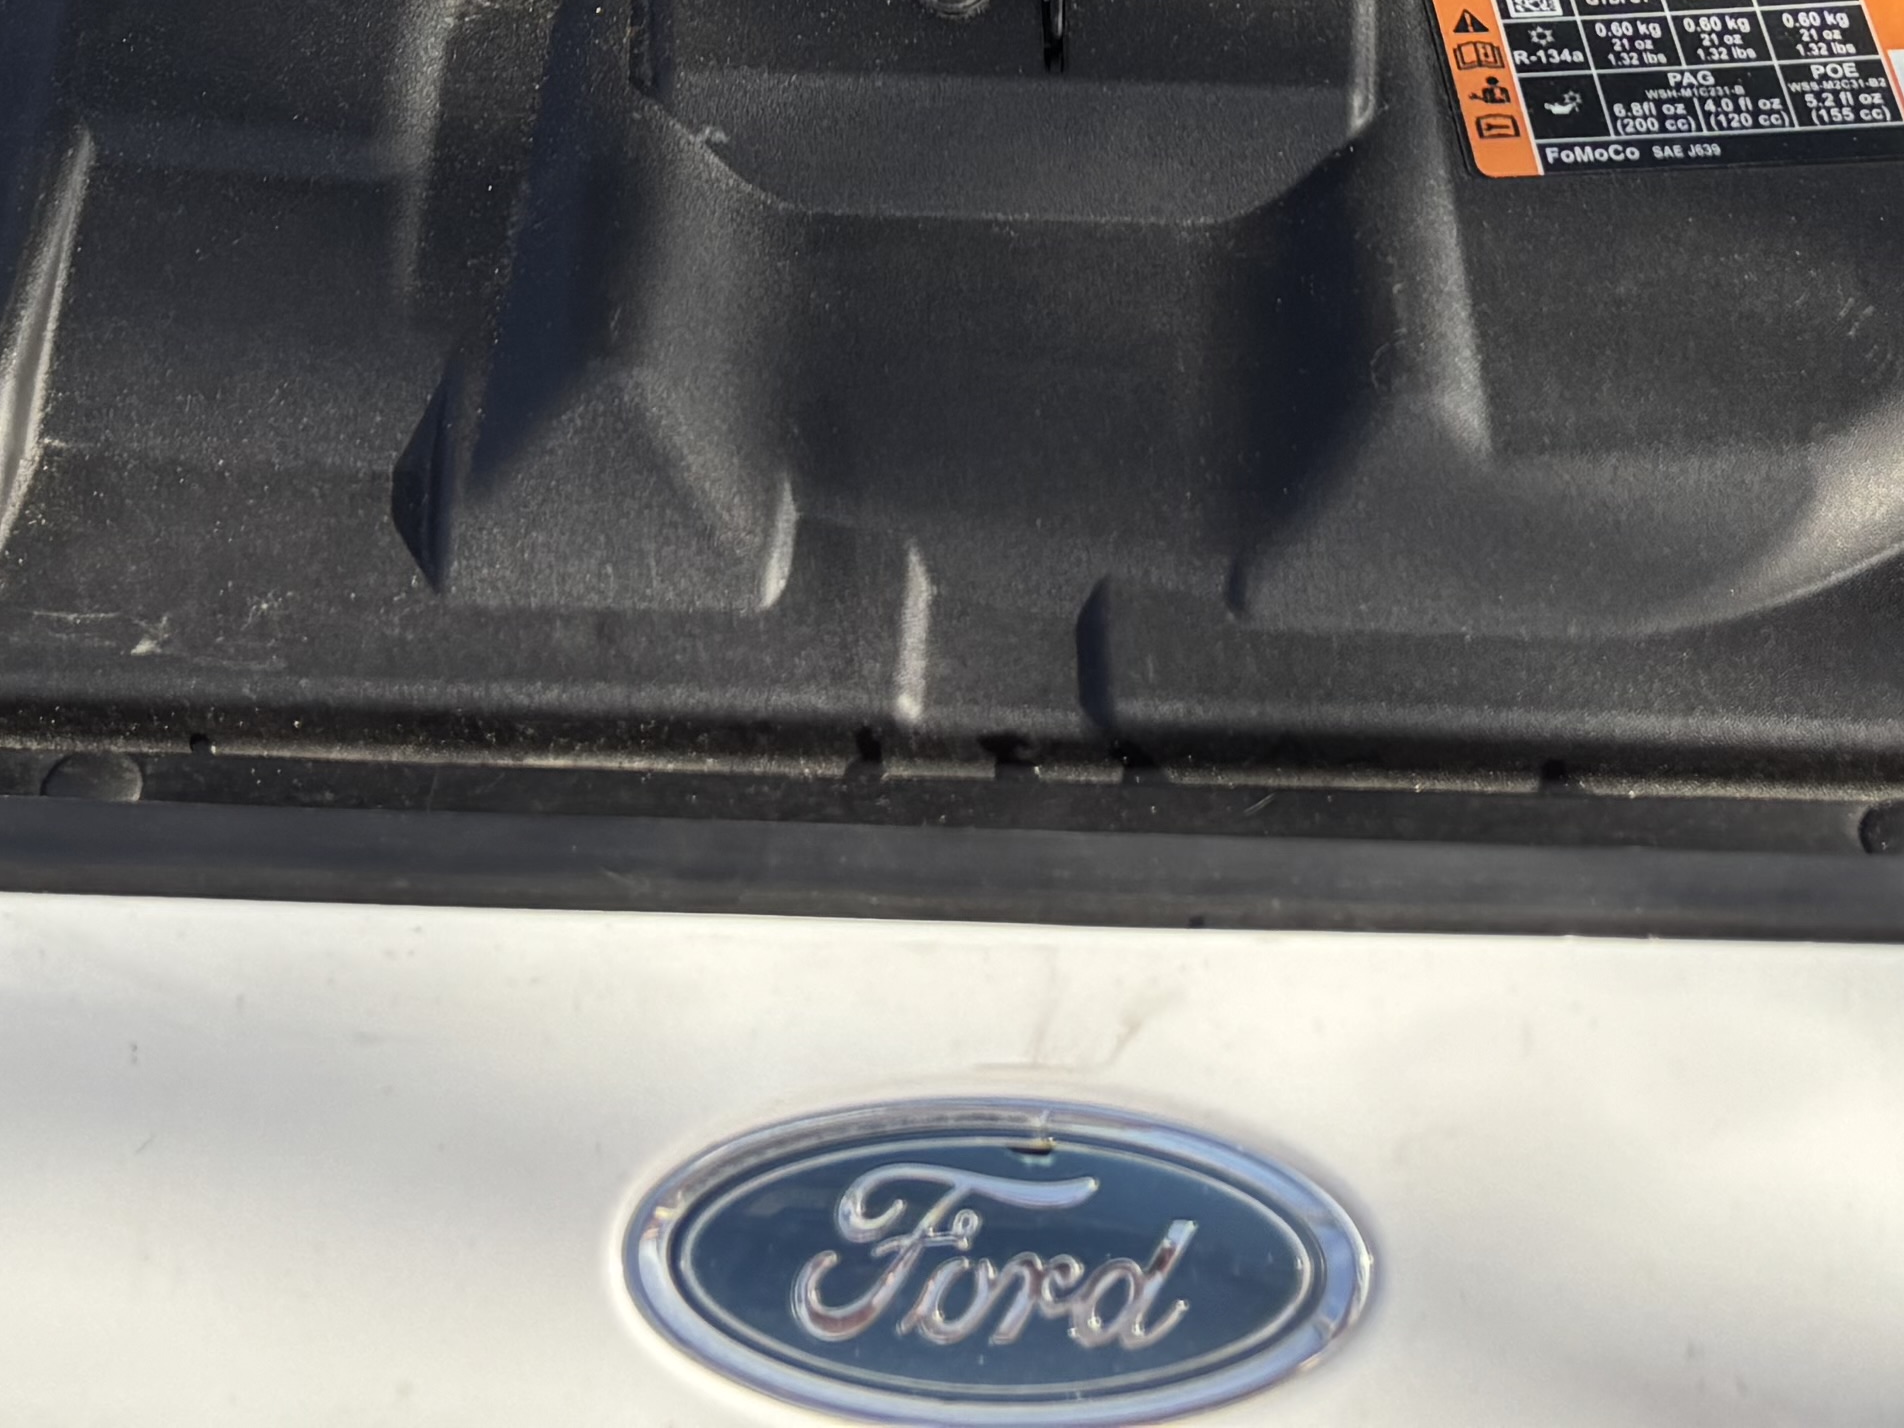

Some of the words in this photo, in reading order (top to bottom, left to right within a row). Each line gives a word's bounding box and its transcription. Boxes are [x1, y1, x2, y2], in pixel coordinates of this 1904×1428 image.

[1683, 16, 1722, 33] 0.60
[1724, 15, 1751, 34] kg
[1781, 11, 1821, 29] 0.60
[1824, 10, 1850, 29] kg
[1594, 21, 1634, 39] 0.60
[1638, 20, 1663, 39] kg
[1799, 28, 1819, 43] 21
[1822, 28, 1843, 42] oz
[1611, 38, 1631, 51] 21
[1634, 39, 1654, 51] oz
[1700, 33, 1719, 47] 21
[1723, 33, 1743, 46] oz
[1795, 43, 1829, 57] 1.32
[1831, 41, 1857, 56] lbs
[1513, 48, 1585, 66] R-134a
[1607, 52, 1639, 66] 1.32
[1642, 51, 1668, 65] lbs
[1696, 47, 1729, 61] 1.32
[1731, 46, 1757, 60] lbs
[1667, 70, 1716, 87] PAG
[1810, 62, 1860, 80] POE
[1704, 97, 1735, 113] 4.0
[1738, 96, 1754, 112] fl
[1758, 97, 1784, 112] oz
[1804, 92, 1836, 108] 5.2
[1839, 90, 1855, 107] fl
[1858, 92, 1885, 106] oz
[1662, 102, 1688, 116] oz
[1811, 107, 1856, 126] (155
[1860, 104, 1893, 122] cc)
[1616, 118, 1660, 136] (200
[1665, 116, 1697, 133] cc)
[1709, 113, 1754, 131] (120
[1758, 110, 1791, 128] cc)
[1545, 144, 1641, 165] FoMoCo
[1652, 145, 1684, 160] SAE
[1688, 143, 1722, 158] J639
[792, 1161, 1200, 1350] Ford
